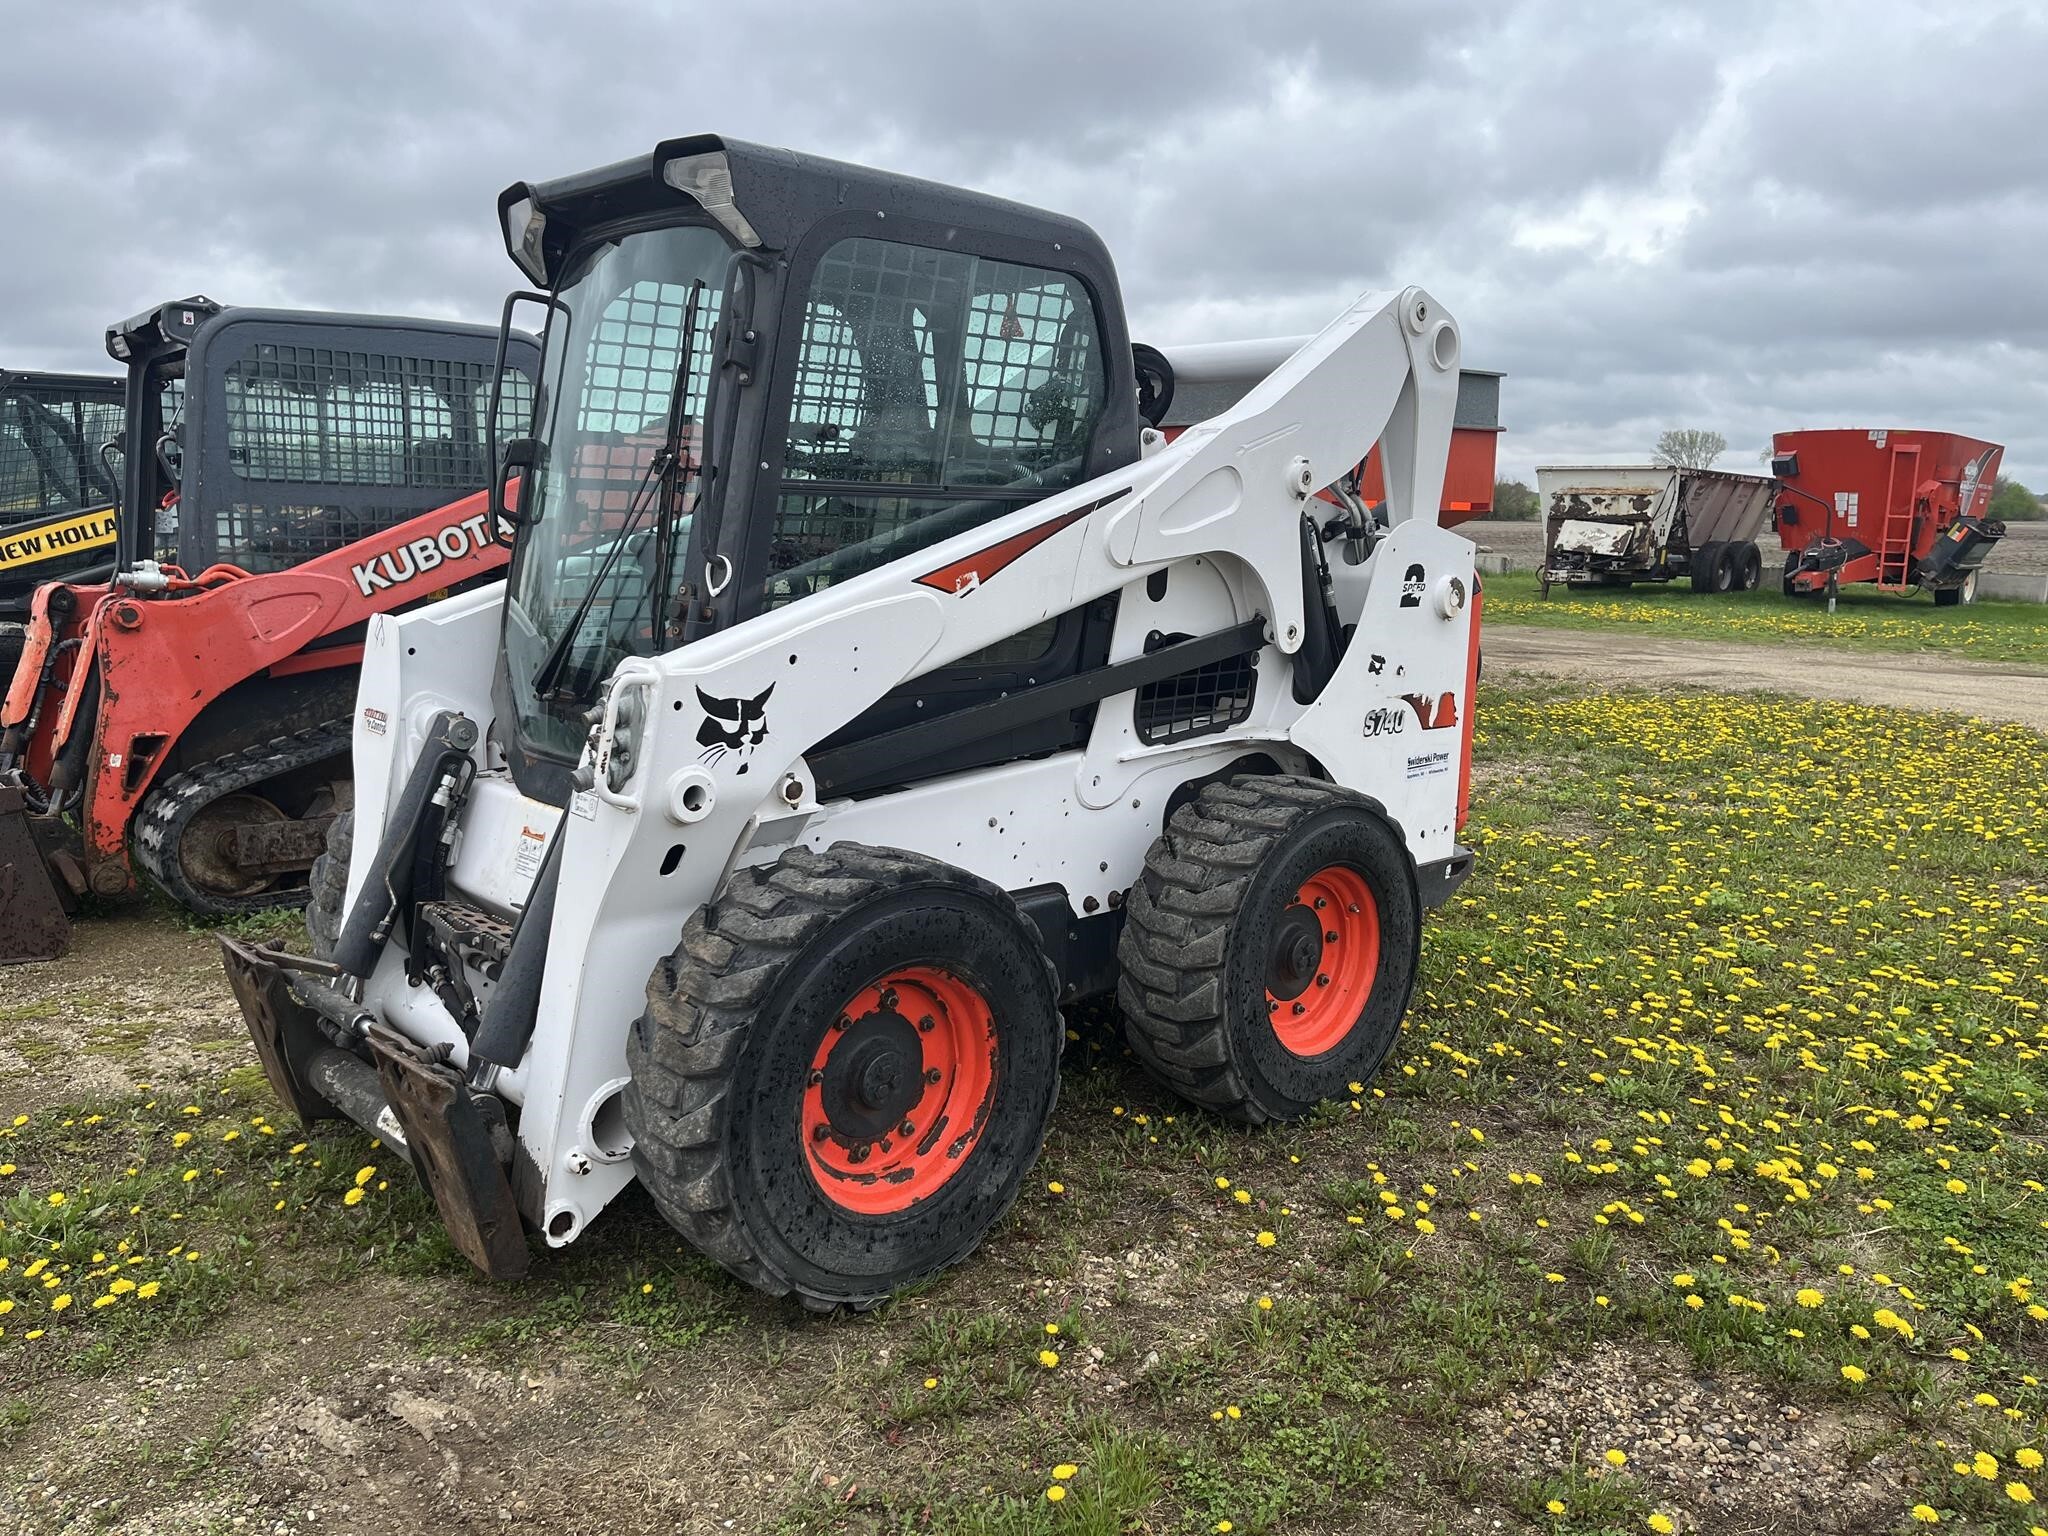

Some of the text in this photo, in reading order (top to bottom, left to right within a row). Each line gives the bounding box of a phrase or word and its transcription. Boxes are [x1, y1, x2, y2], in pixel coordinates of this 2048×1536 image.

[45, 518, 117, 549] HOLLA
[1407, 752, 1450, 767] Swiderski Power
